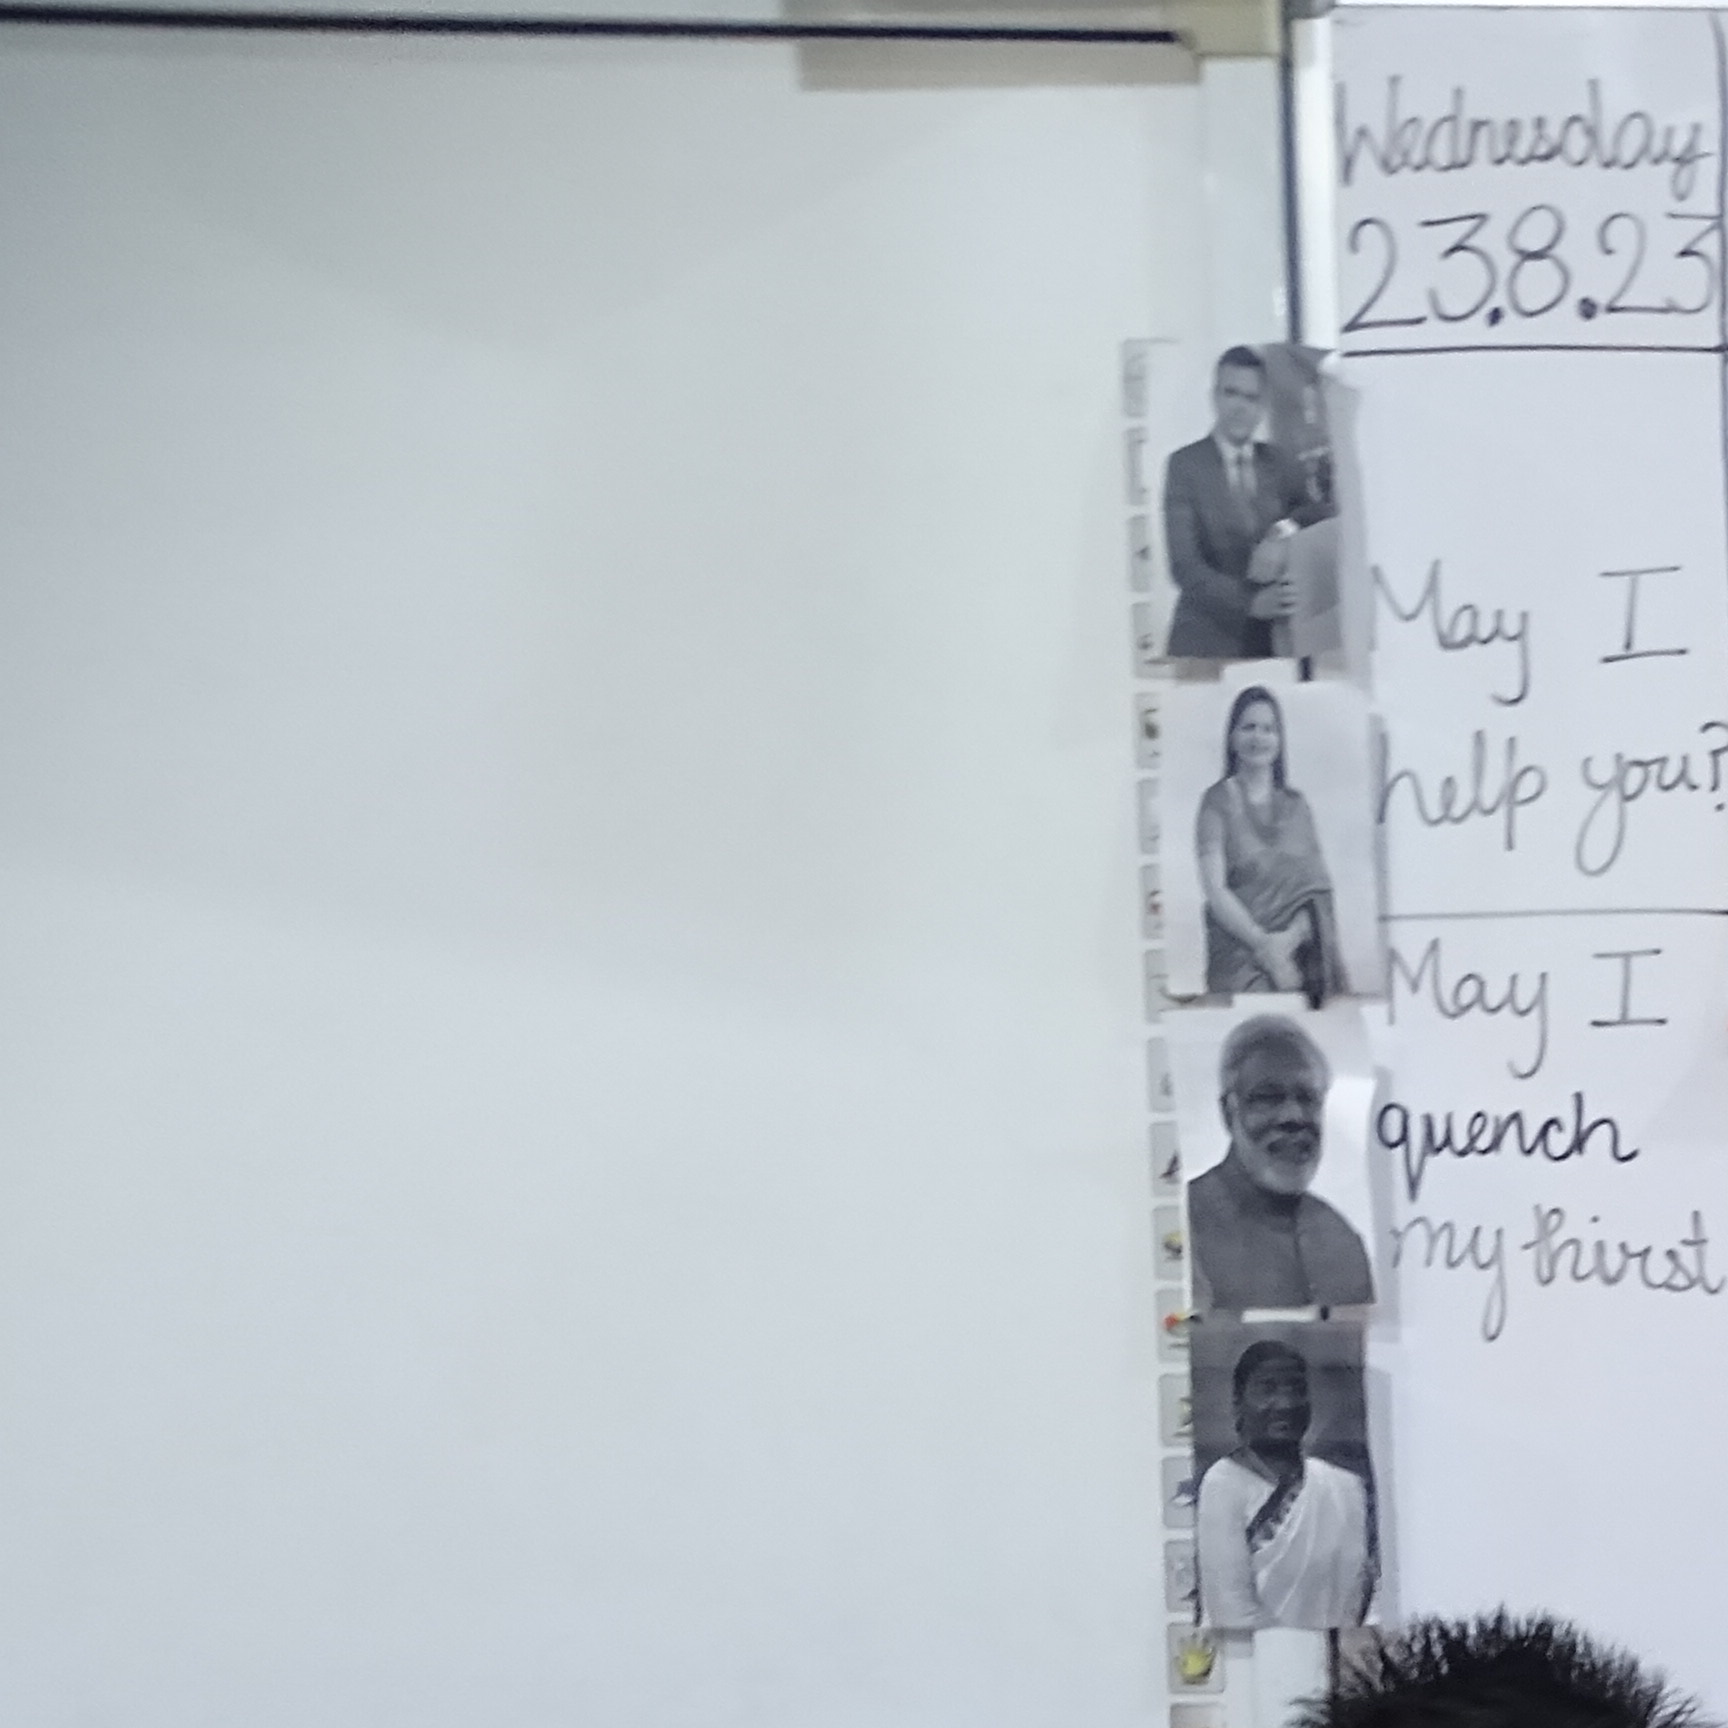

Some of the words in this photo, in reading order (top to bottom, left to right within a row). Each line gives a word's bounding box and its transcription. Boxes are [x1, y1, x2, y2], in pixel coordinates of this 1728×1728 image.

[1336, 75, 1712, 199] Wednesday
[1341, 204, 1720, 333] 23.8.23
[1370, 558, 1529, 706] May
[1600, 565, 1689, 664] I
[1376, 729, 1549, 852] help
[1387, 937, 1549, 1080] May
[1591, 948, 1669, 1028] I
[1376, 1091, 1640, 1203] quench
[1389, 1216, 1507, 1342] my
